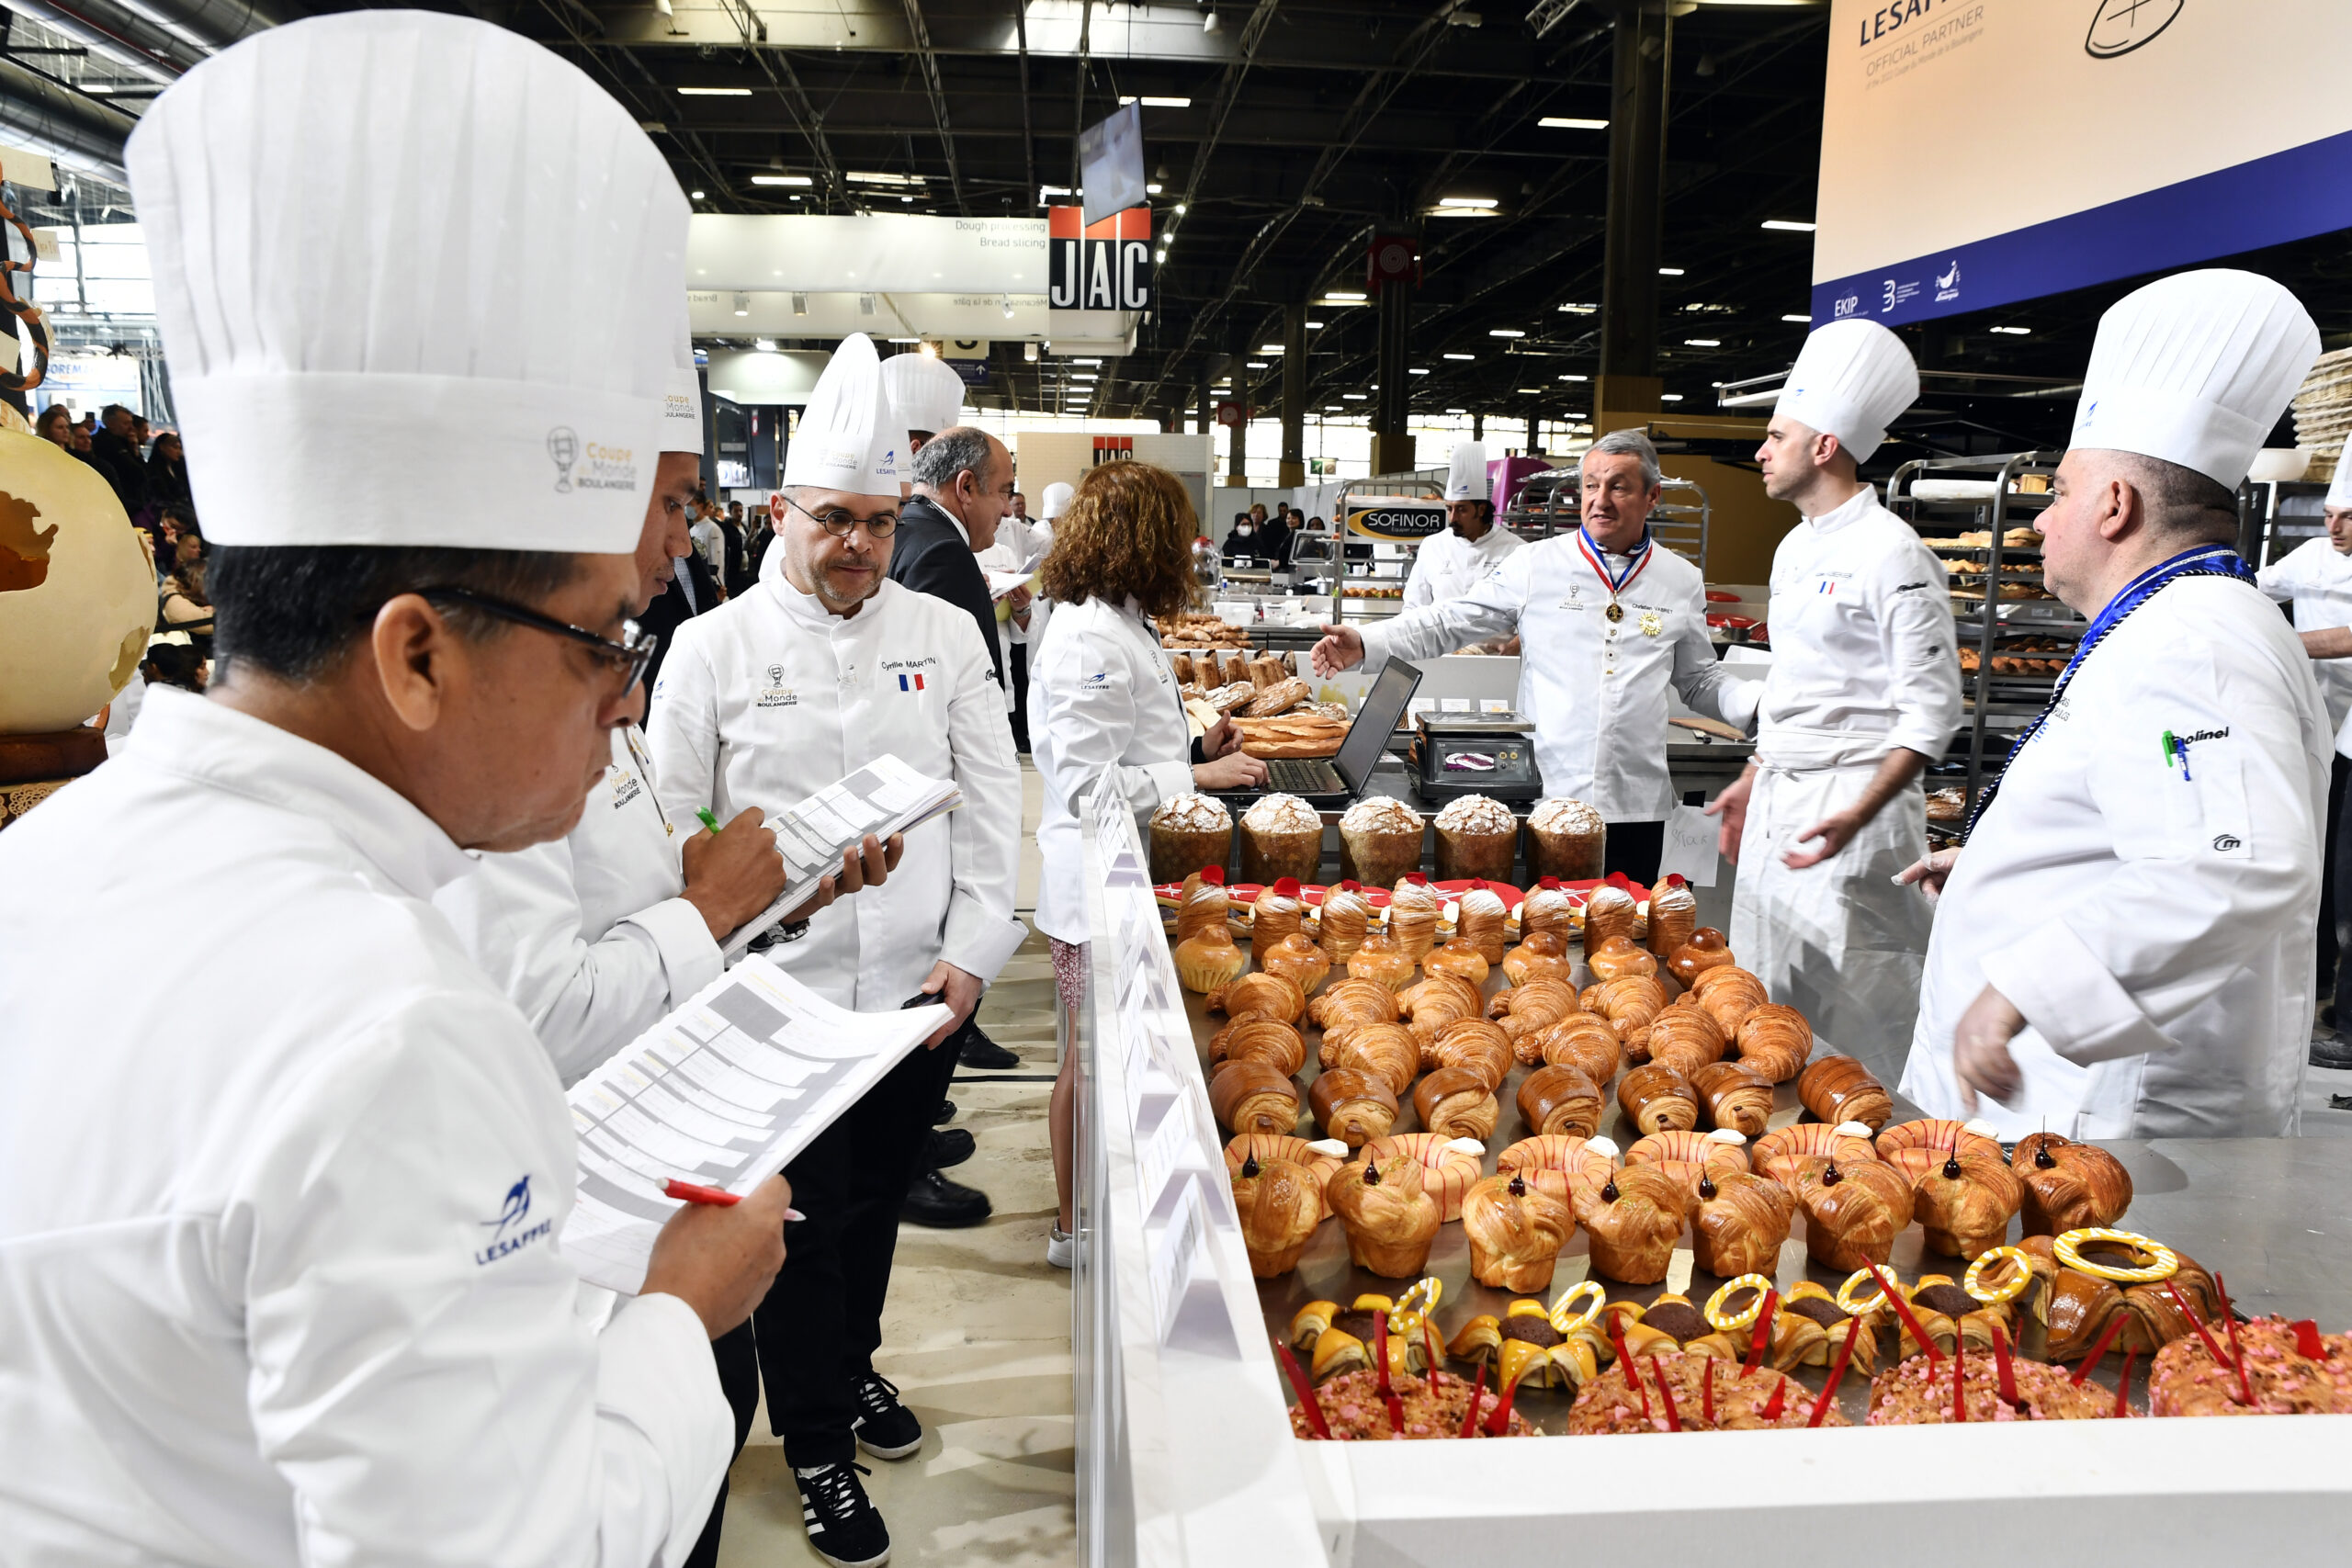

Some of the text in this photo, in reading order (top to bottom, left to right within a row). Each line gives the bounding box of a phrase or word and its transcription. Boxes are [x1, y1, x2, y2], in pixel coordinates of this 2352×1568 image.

[1866, 6, 1984, 77] OFFICIAL PARTNER
[956, 220, 988, 232] Dough
[979, 237, 1046, 249] Bread slicing
[1051, 241, 1148, 309] JAC
[1834, 296, 1859, 318] EKIP
[586, 442, 632, 463] Coupe
[1368, 513, 1440, 527] SOFINOR
[881, 657, 936, 671] Cyrille MARTIN
[764, 694, 797, 703] Monde
[616, 778, 638, 798] Monde
